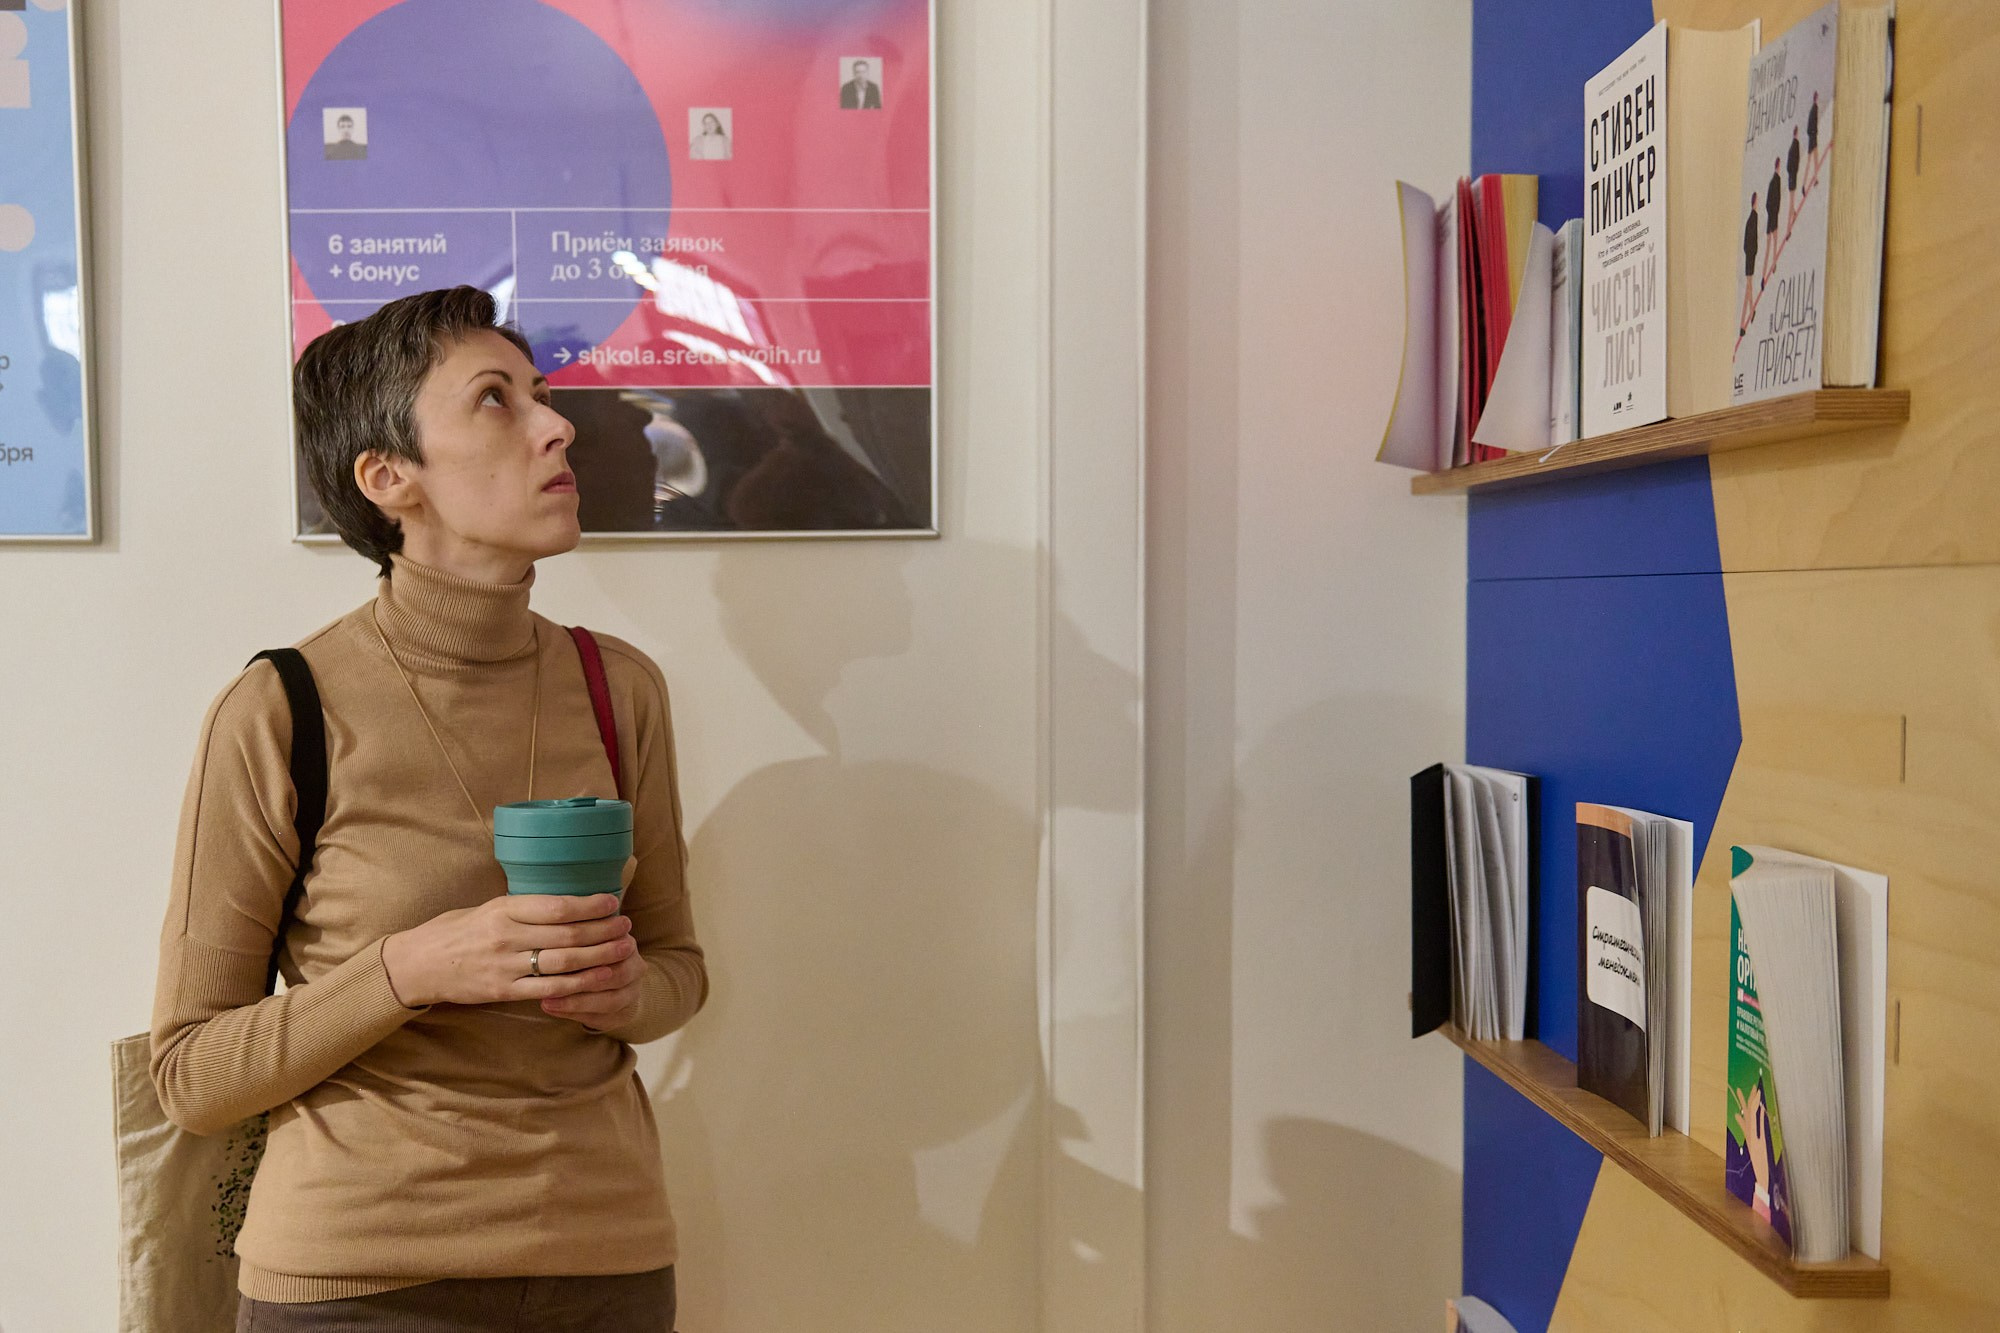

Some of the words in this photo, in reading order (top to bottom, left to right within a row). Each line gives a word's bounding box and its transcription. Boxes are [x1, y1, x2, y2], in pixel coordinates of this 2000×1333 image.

[1591, 75, 1655, 172] СТИВЕН
[1745, 75, 1798, 151] ДАНИЛОВ
[1591, 145, 1656, 236] ПИНКЕР
[328, 234, 344, 254] 6
[350, 233, 447, 254] занятий
[348, 261, 420, 286] бонус
[550, 230, 632, 258] Приём
[640, 236, 725, 252] заявок
[550, 264, 581, 281] до
[587, 258, 602, 280] 3
[1591, 242, 1656, 333] ЧИСТЫЙ
[1603, 323, 1644, 388] ЛИСТ
[1755, 324, 1816, 391] ПРИВЕТ!
